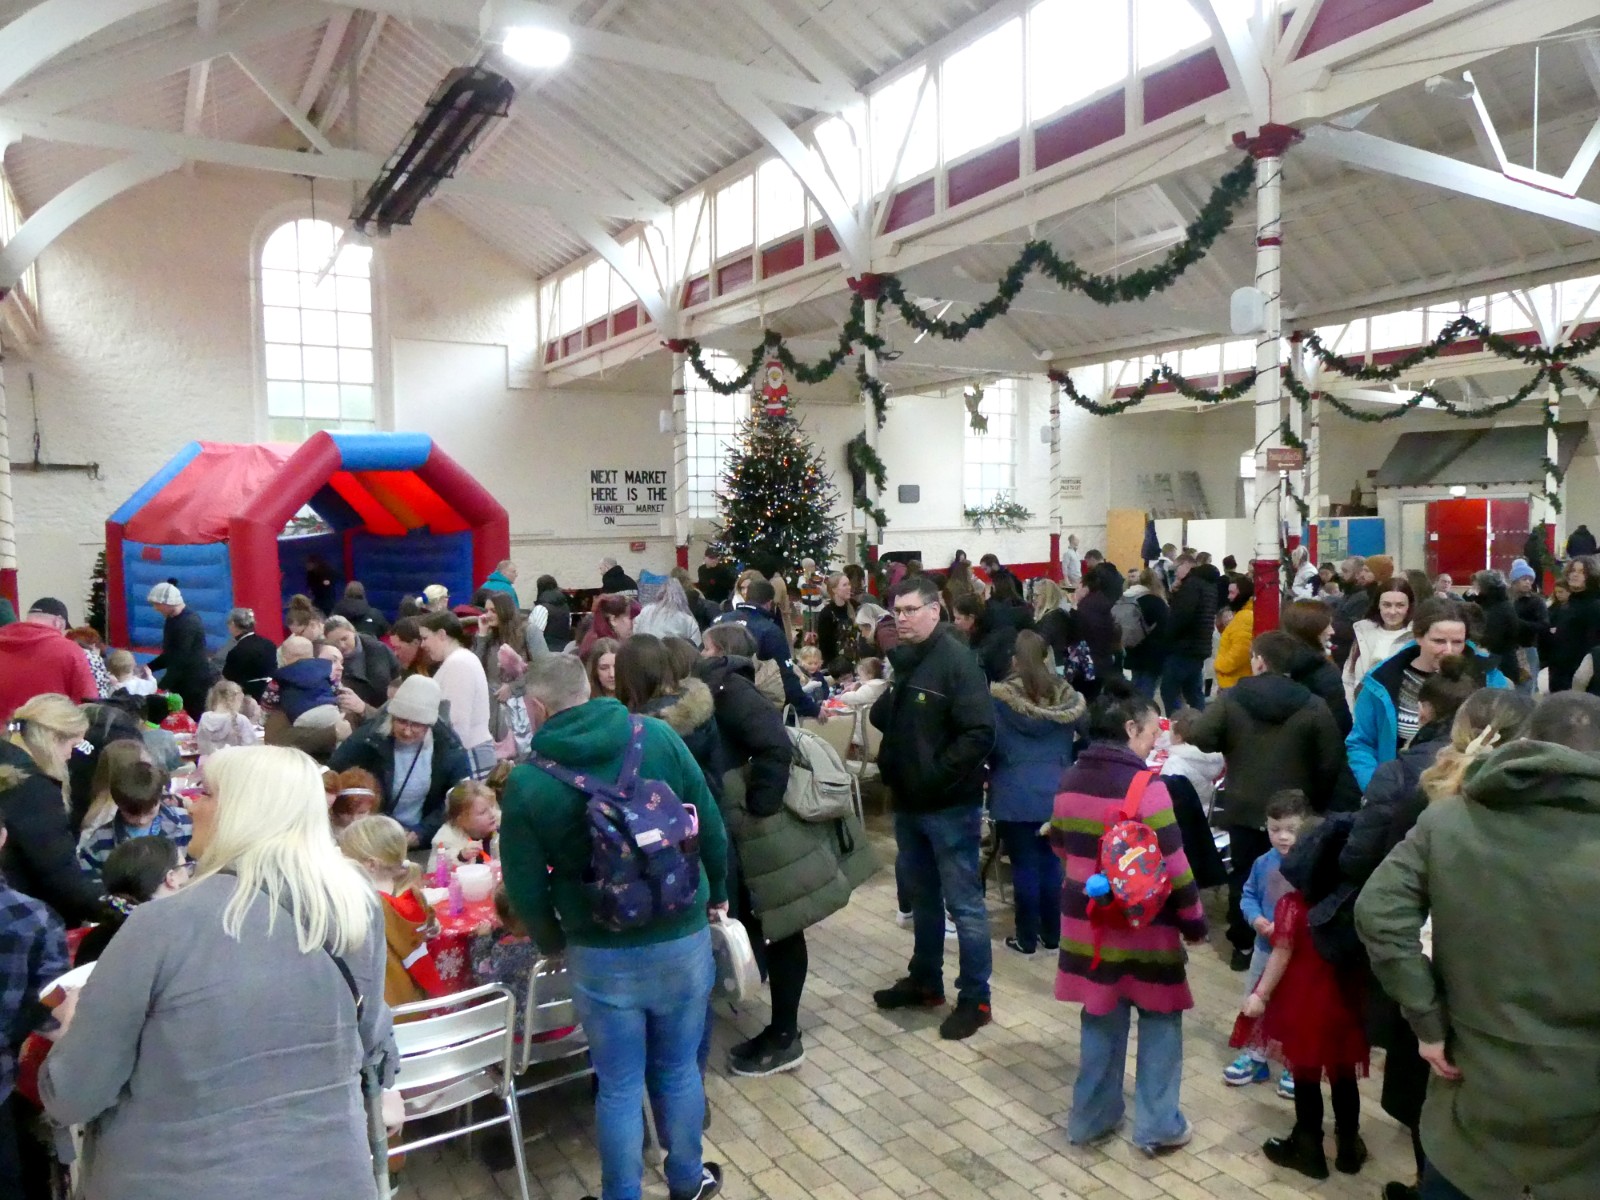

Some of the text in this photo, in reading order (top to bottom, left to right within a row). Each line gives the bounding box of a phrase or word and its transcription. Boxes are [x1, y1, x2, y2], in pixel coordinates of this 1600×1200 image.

[591, 470, 667, 484] NEXT MARKET
[591, 487, 667, 501] HERE IS THE
[594, 504, 664, 514] PANNIER MARKET
[604, 516, 615, 525] ON
